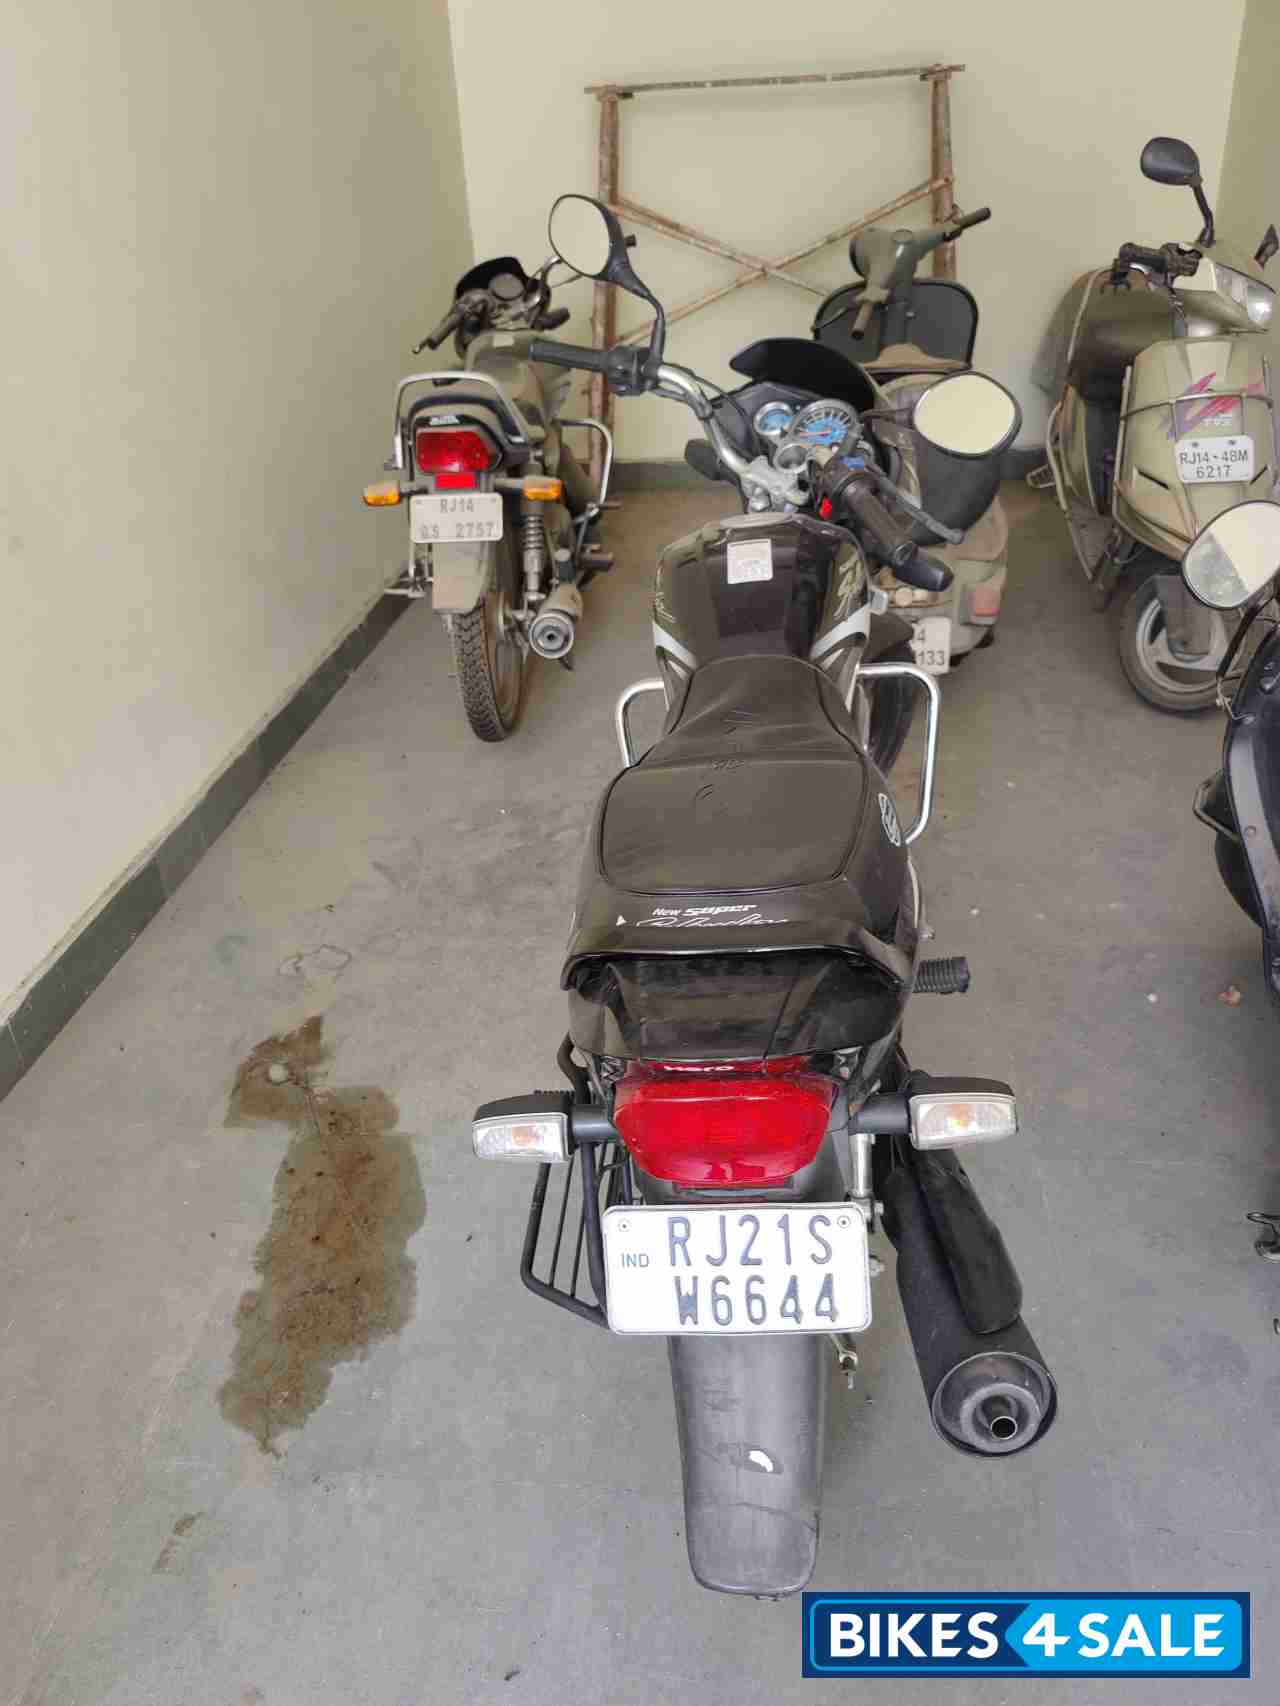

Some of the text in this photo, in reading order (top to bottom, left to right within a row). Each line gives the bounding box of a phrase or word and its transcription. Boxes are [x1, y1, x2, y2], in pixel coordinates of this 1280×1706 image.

[1196, 464, 1231, 479] 6217
[440, 498, 474, 513] RJ14
[652, 908, 682, 916] New
[621, 1214, 833, 1268] IND RJ21S
[673, 1273, 839, 1326] W6644
